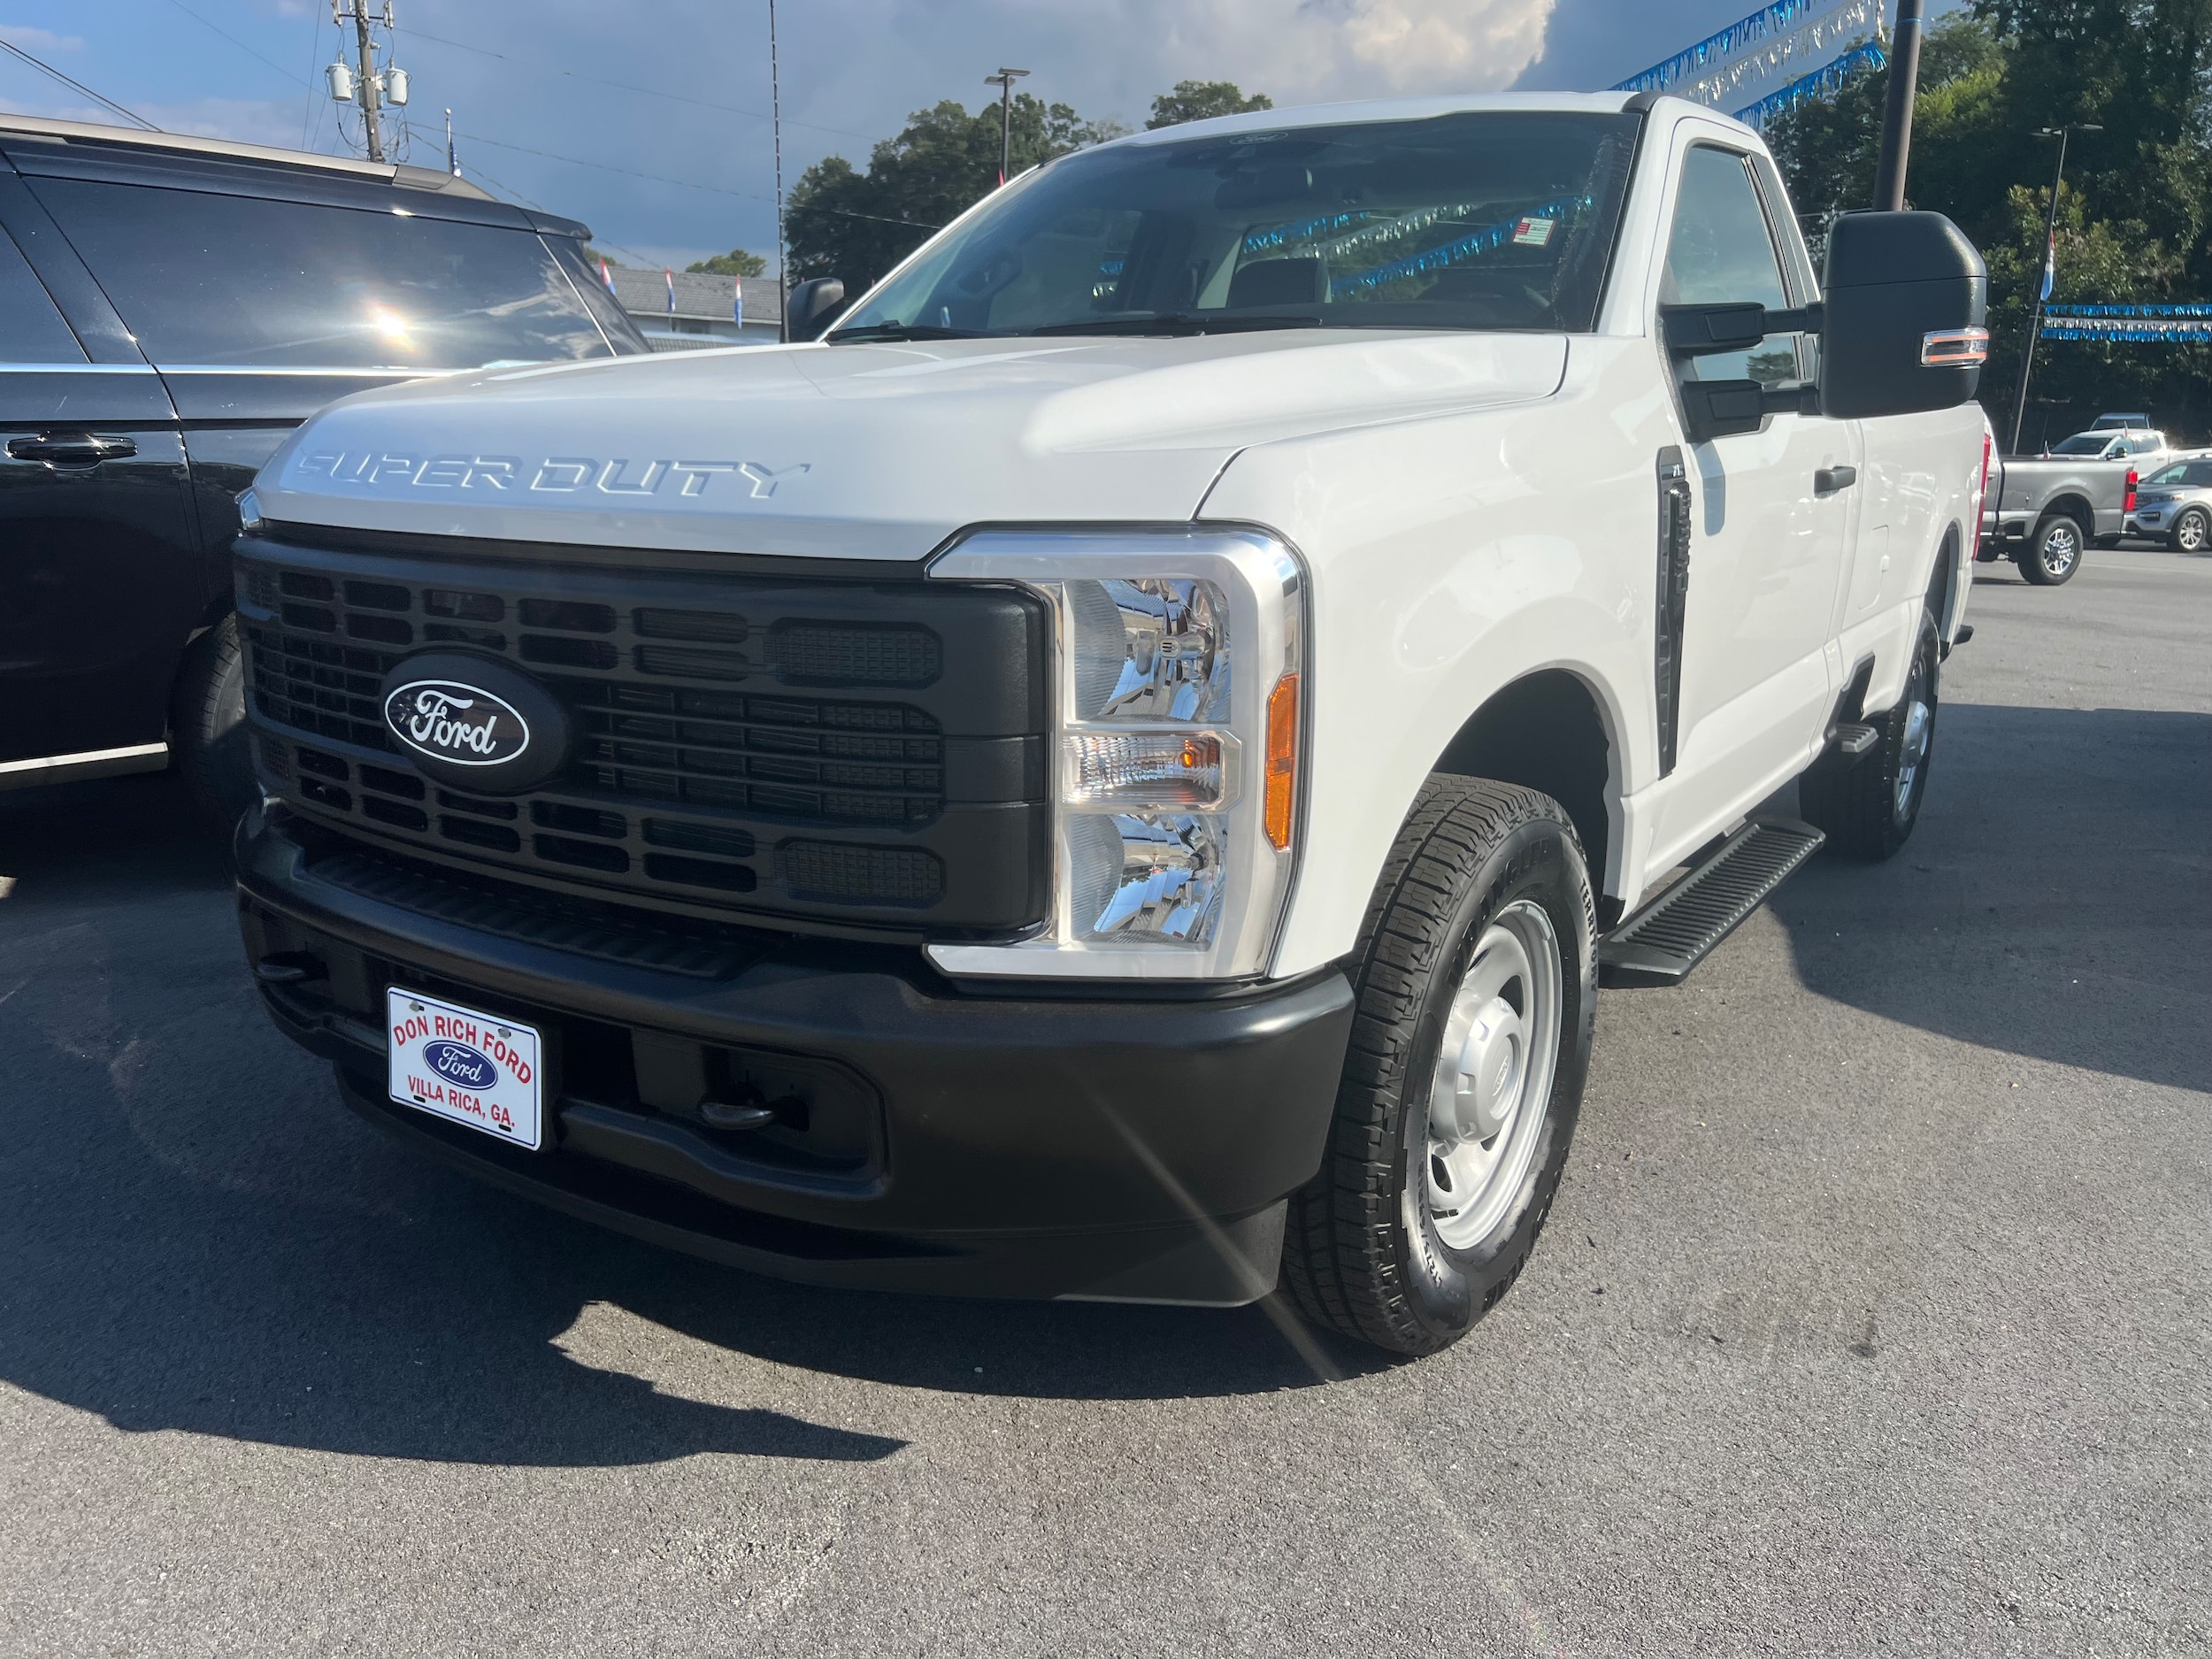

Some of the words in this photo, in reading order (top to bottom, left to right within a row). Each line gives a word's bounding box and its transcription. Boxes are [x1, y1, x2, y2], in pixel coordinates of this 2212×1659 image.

[297, 450, 524, 490] SUPER
[530, 457, 811, 499] DUTY
[411, 689, 498, 755] Ford
[394, 1015, 429, 1047] DON
[434, 1015, 477, 1046] RICH
[482, 1031, 532, 1084] FORD
[437, 1046, 483, 1082] Ford
[407, 1074, 444, 1102] VILLA
[449, 1088, 486, 1120] RICA,
[490, 1103, 515, 1127] GA.
